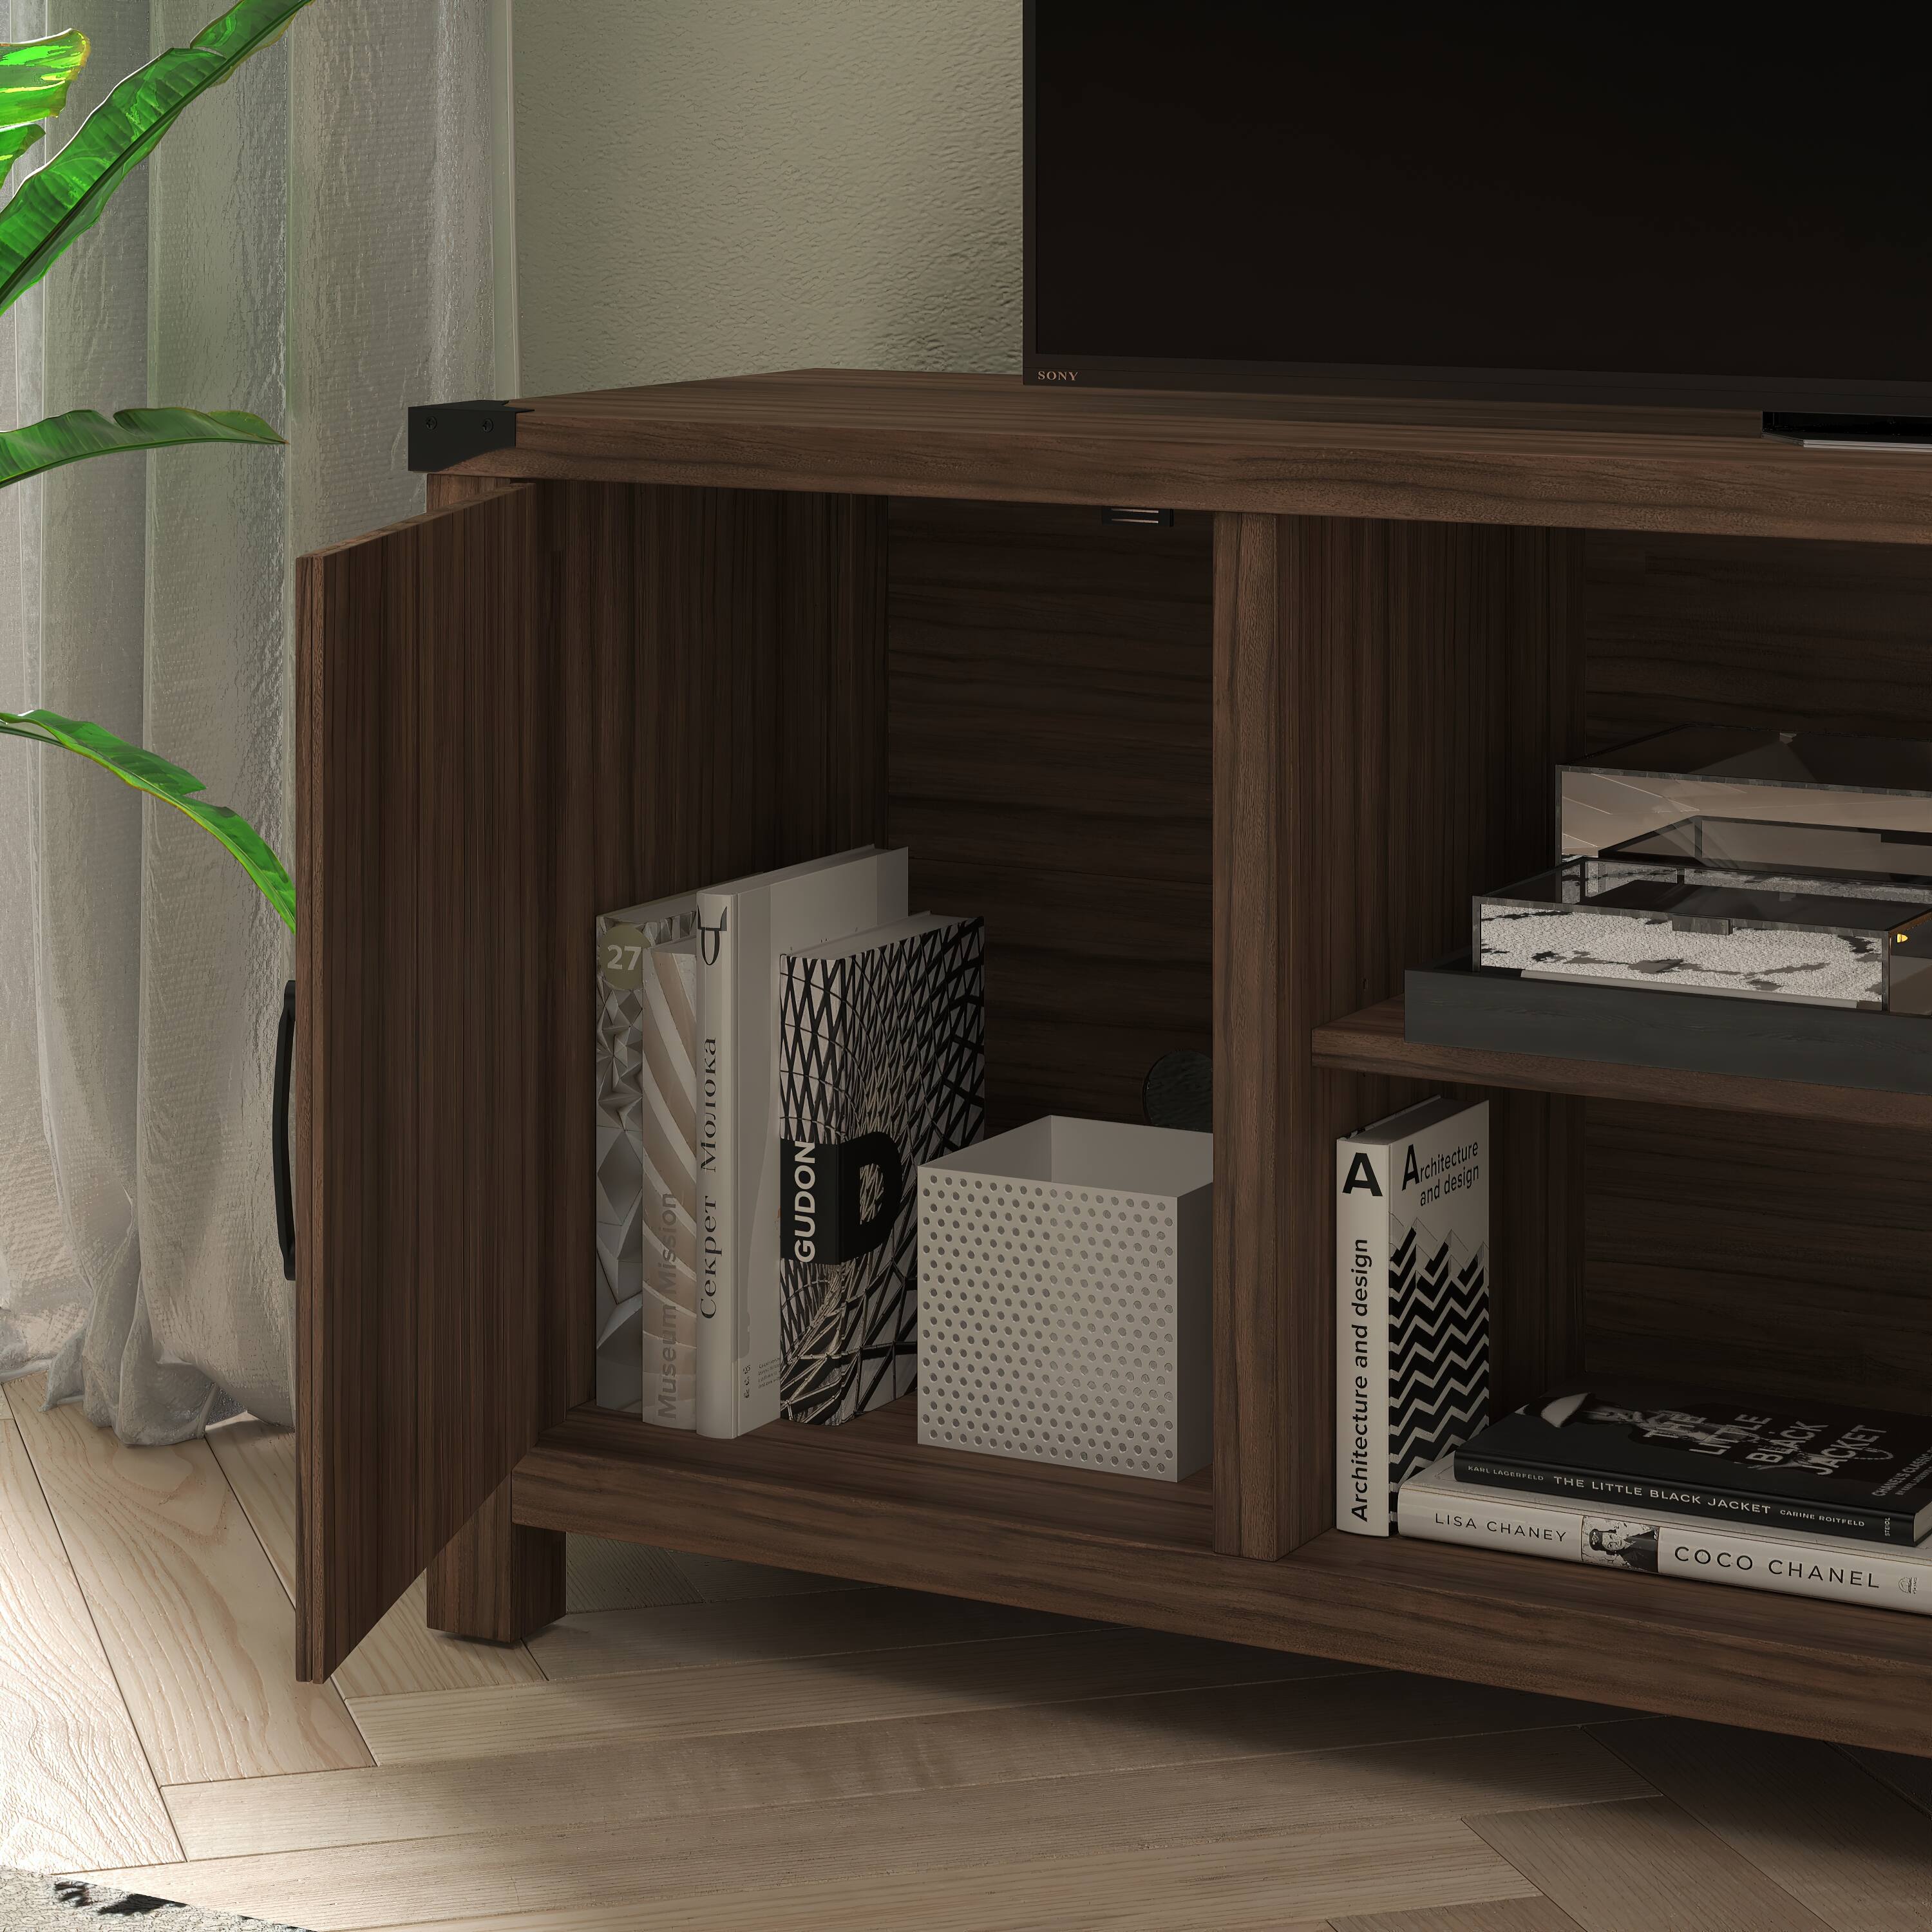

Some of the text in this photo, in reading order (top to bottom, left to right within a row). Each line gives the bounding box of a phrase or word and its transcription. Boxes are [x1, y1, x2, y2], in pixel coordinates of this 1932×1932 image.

[1037, 370, 1078, 381] SONY
[607, 944, 641, 971] 27
[700, 1037, 723, 1319] Секрет Молока
[1342, 1153, 1383, 1197] A
[1401, 1142, 1479, 1191] Architecture
[1420, 1166, 1479, 1206] and design
[793, 1141, 815, 1263] GUDON
[658, 1193, 676, 1419] Museum Mission
[1350, 1238, 1372, 1522] Architecture and design
[1643, 1411, 1708, 1439] THE
[1689, 1414, 1773, 1455] LITTLE
[1745, 1421, 1829, 1463] BLACK
[1798, 1424, 1888, 1475] JACKET
[1468, 1465, 1490, 1473] KARL
[1553, 1476, 1584, 1488] THE
[1592, 1481, 1642, 1497] LITTLE
[1650, 1490, 1701, 1505] BLACK
[1707, 1497, 1772, 1515] JACKET
[1779, 1510, 1815, 1520] CARINE
[1819, 1515, 1866, 1528] ROITFELD
[1435, 1513, 1567, 1542] LISA CHANEY
[1674, 1546, 1754, 1571] COCO
[1768, 1558, 1880, 1589] CHANEL
